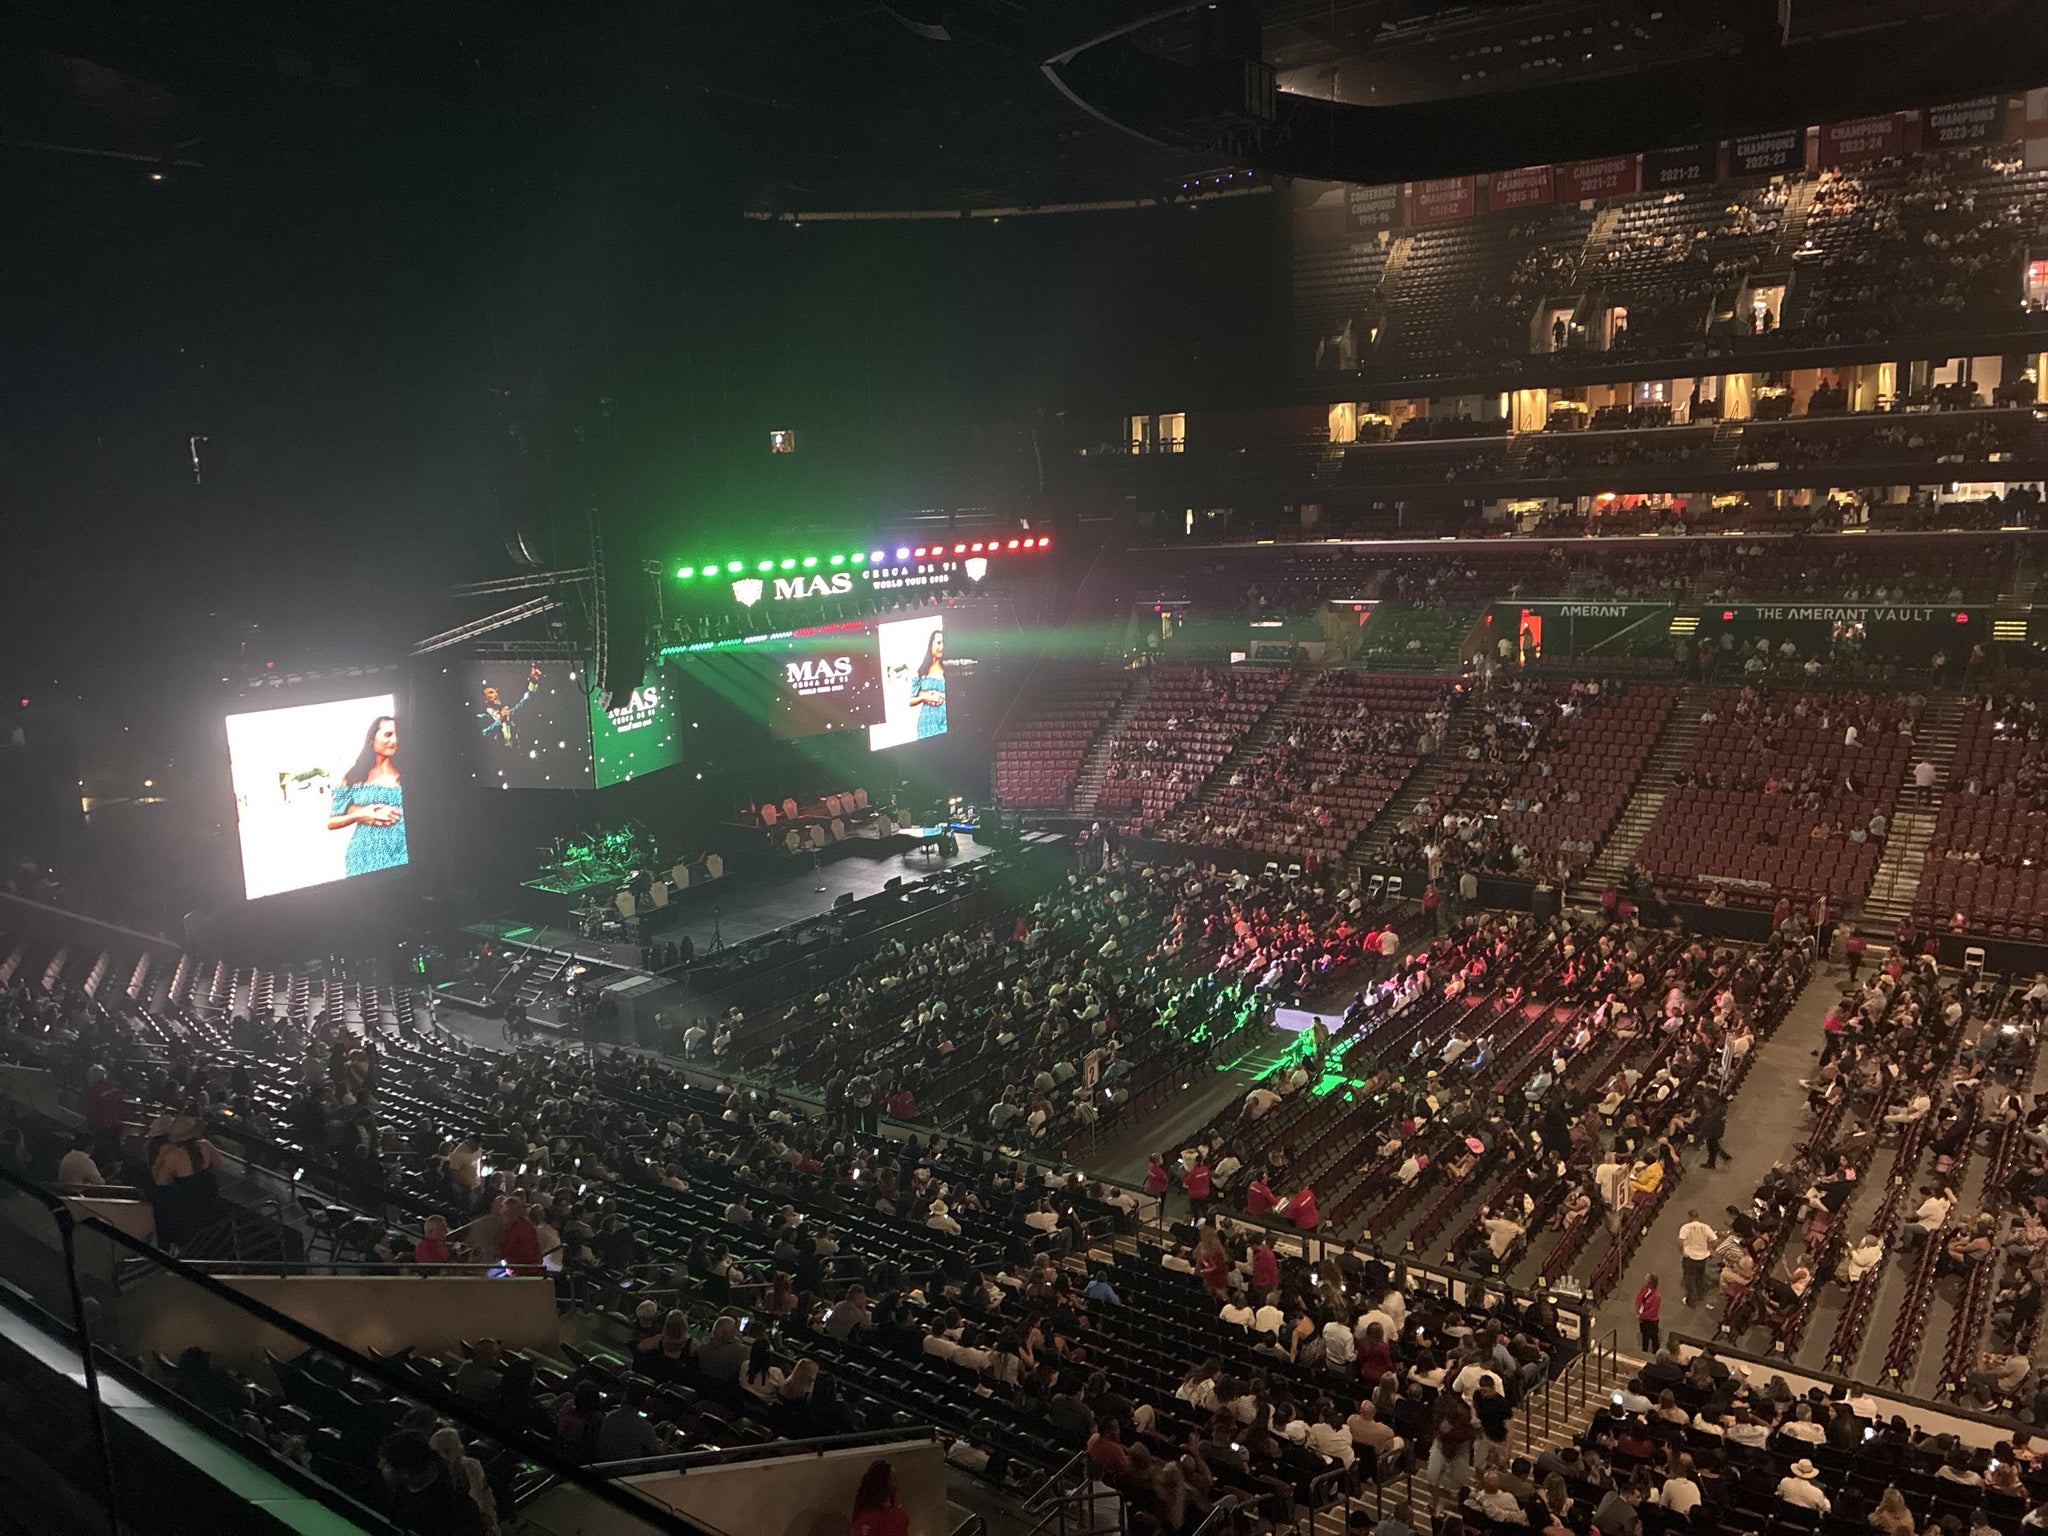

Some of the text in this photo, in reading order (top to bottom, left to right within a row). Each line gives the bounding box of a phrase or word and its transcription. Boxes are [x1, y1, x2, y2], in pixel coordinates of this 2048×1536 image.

[1931, 107, 1996, 127] CHAMPIONS
[1830, 120, 1893, 140] CHAMPIONS
[1737, 136, 1796, 157] CHAMPIONS
[1573, 160, 1626, 179] CHAMPIONS
[1745, 152, 1786, 169] 2022-23
[1660, 165, 1700, 182] 2021-22
[1496, 174, 1547, 192] CHAMPIONS
[1580, 175, 1617, 192] 2021-22
[1350, 185, 1398, 203] CONFERENCE
[1421, 189, 1468, 205] CHAMPIONS
[1351, 198, 1396, 215] CHAMPIONS
[774, 572, 852, 600] MAS
[872, 579, 903, 590] WORLD
[1560, 606, 1629, 617] AMERANT
[1756, 607, 1934, 621] THE AMERANT VAULT
[786, 656, 852, 683] MAS
[1089, 1066, 1095, 1085] 2
[1619, 1182, 1625, 1206] 5
